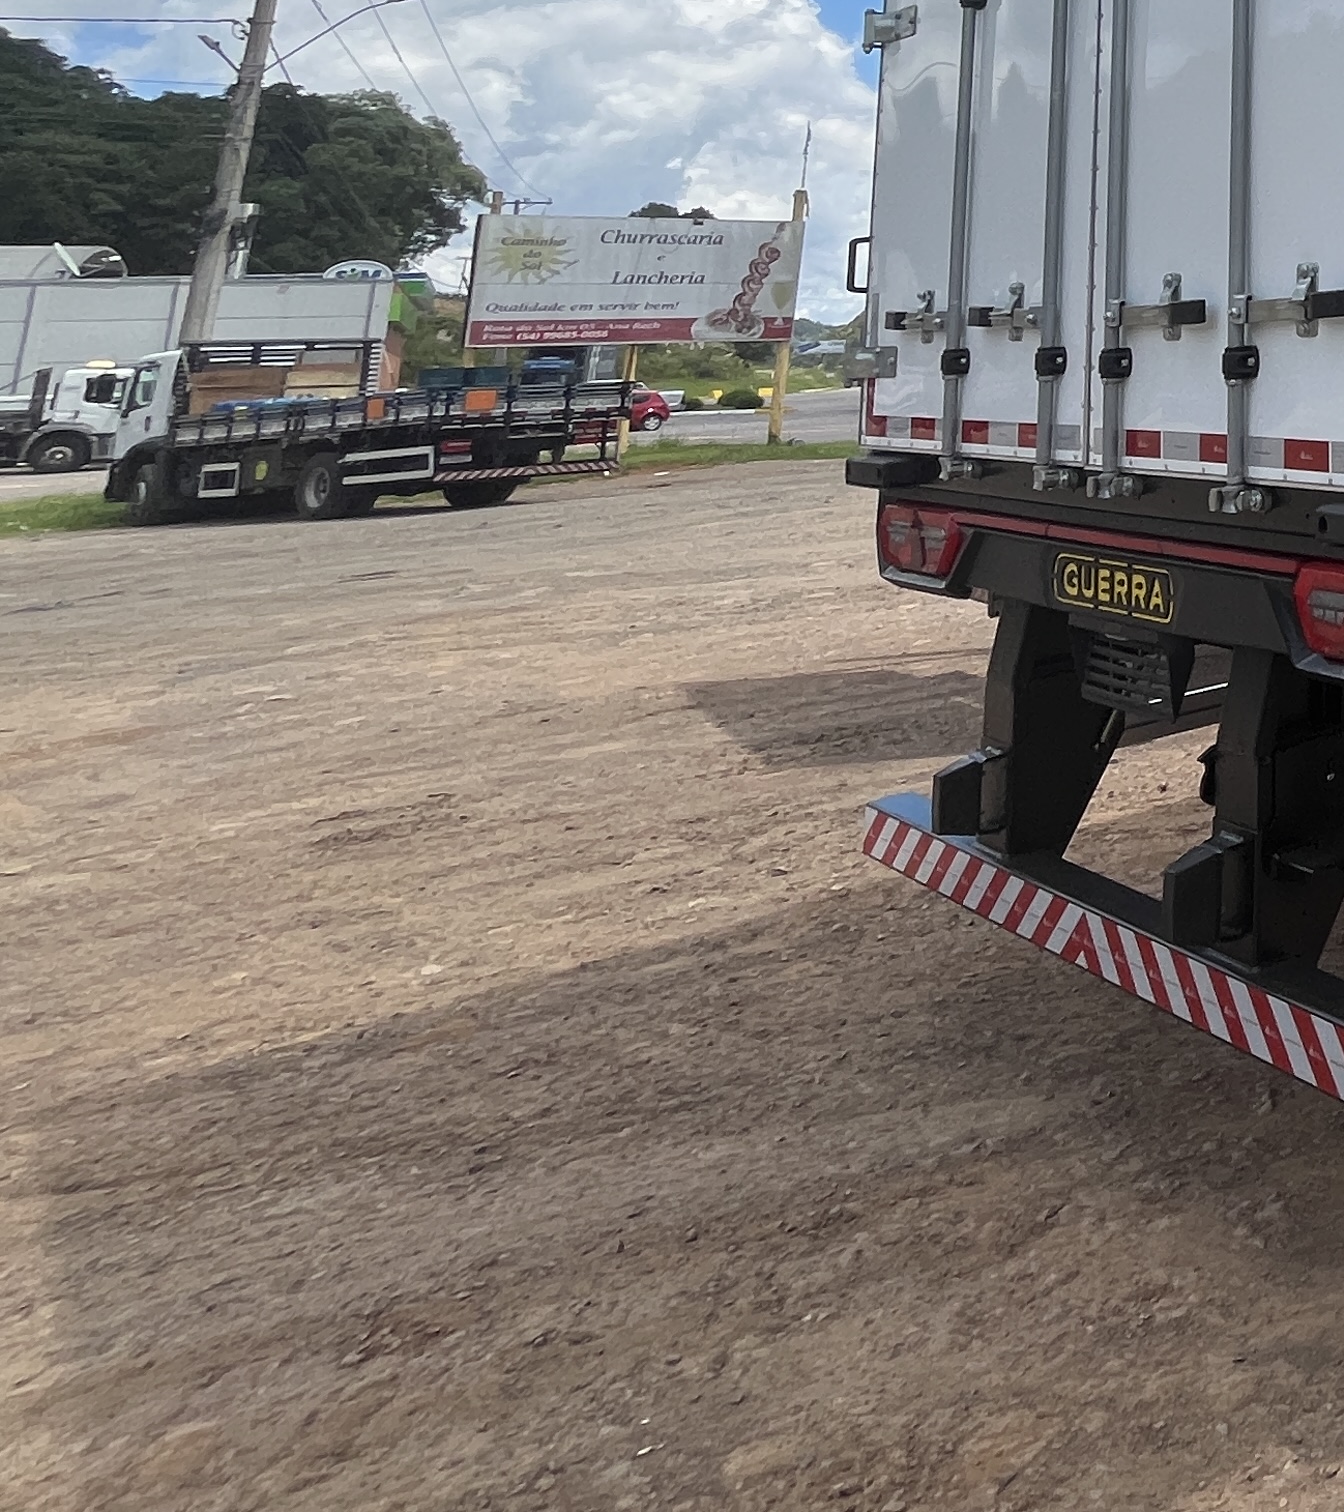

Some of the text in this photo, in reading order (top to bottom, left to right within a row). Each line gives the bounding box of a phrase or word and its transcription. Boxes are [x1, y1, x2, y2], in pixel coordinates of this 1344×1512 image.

[501, 236, 567, 246] Caminho
[600, 229, 724, 245] Churrascaria
[523, 249, 542, 258] do
[521, 261, 542, 270] Sol
[611, 271, 706, 285] Lancheria
[485, 301, 679, 314] Qualidade em servir bem!
[1063, 562, 1165, 613] GUERRA
